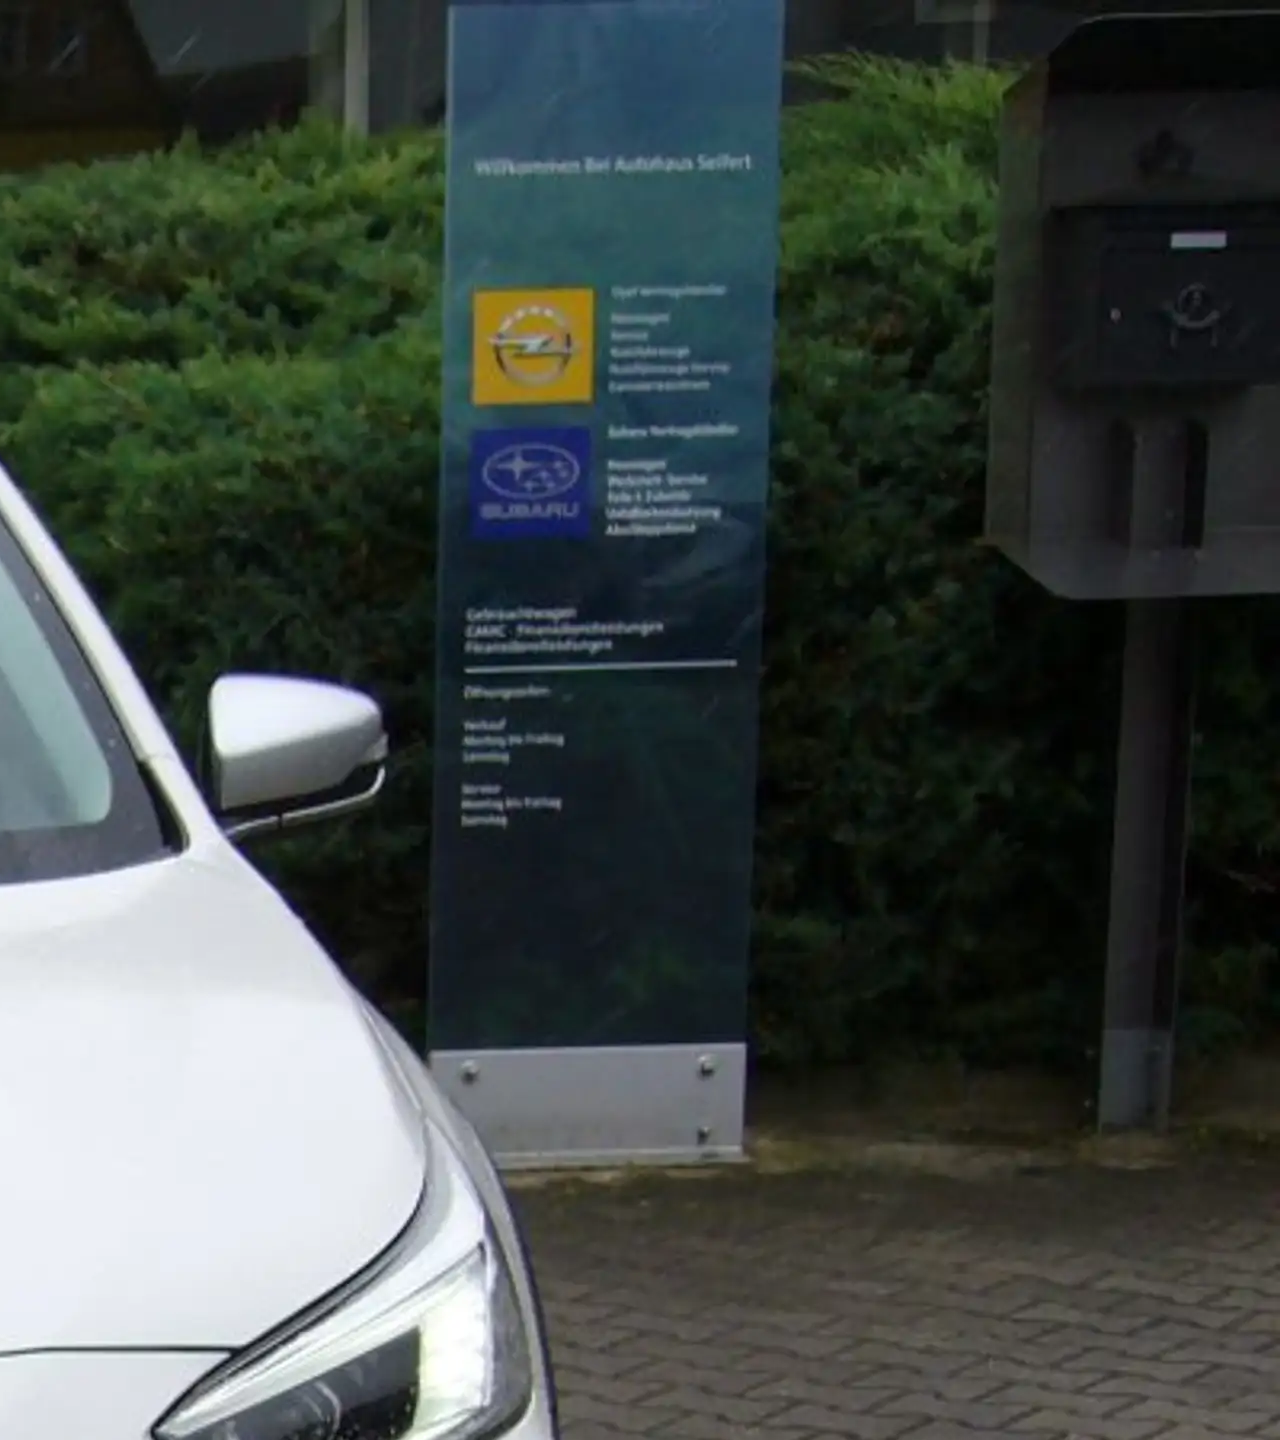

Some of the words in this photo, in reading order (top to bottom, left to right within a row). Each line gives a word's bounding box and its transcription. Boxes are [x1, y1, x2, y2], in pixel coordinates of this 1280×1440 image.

[614, 155, 693, 172] Autohaus
[696, 153, 753, 171] Seifert
[478, 502, 580, 520] SUBARU
